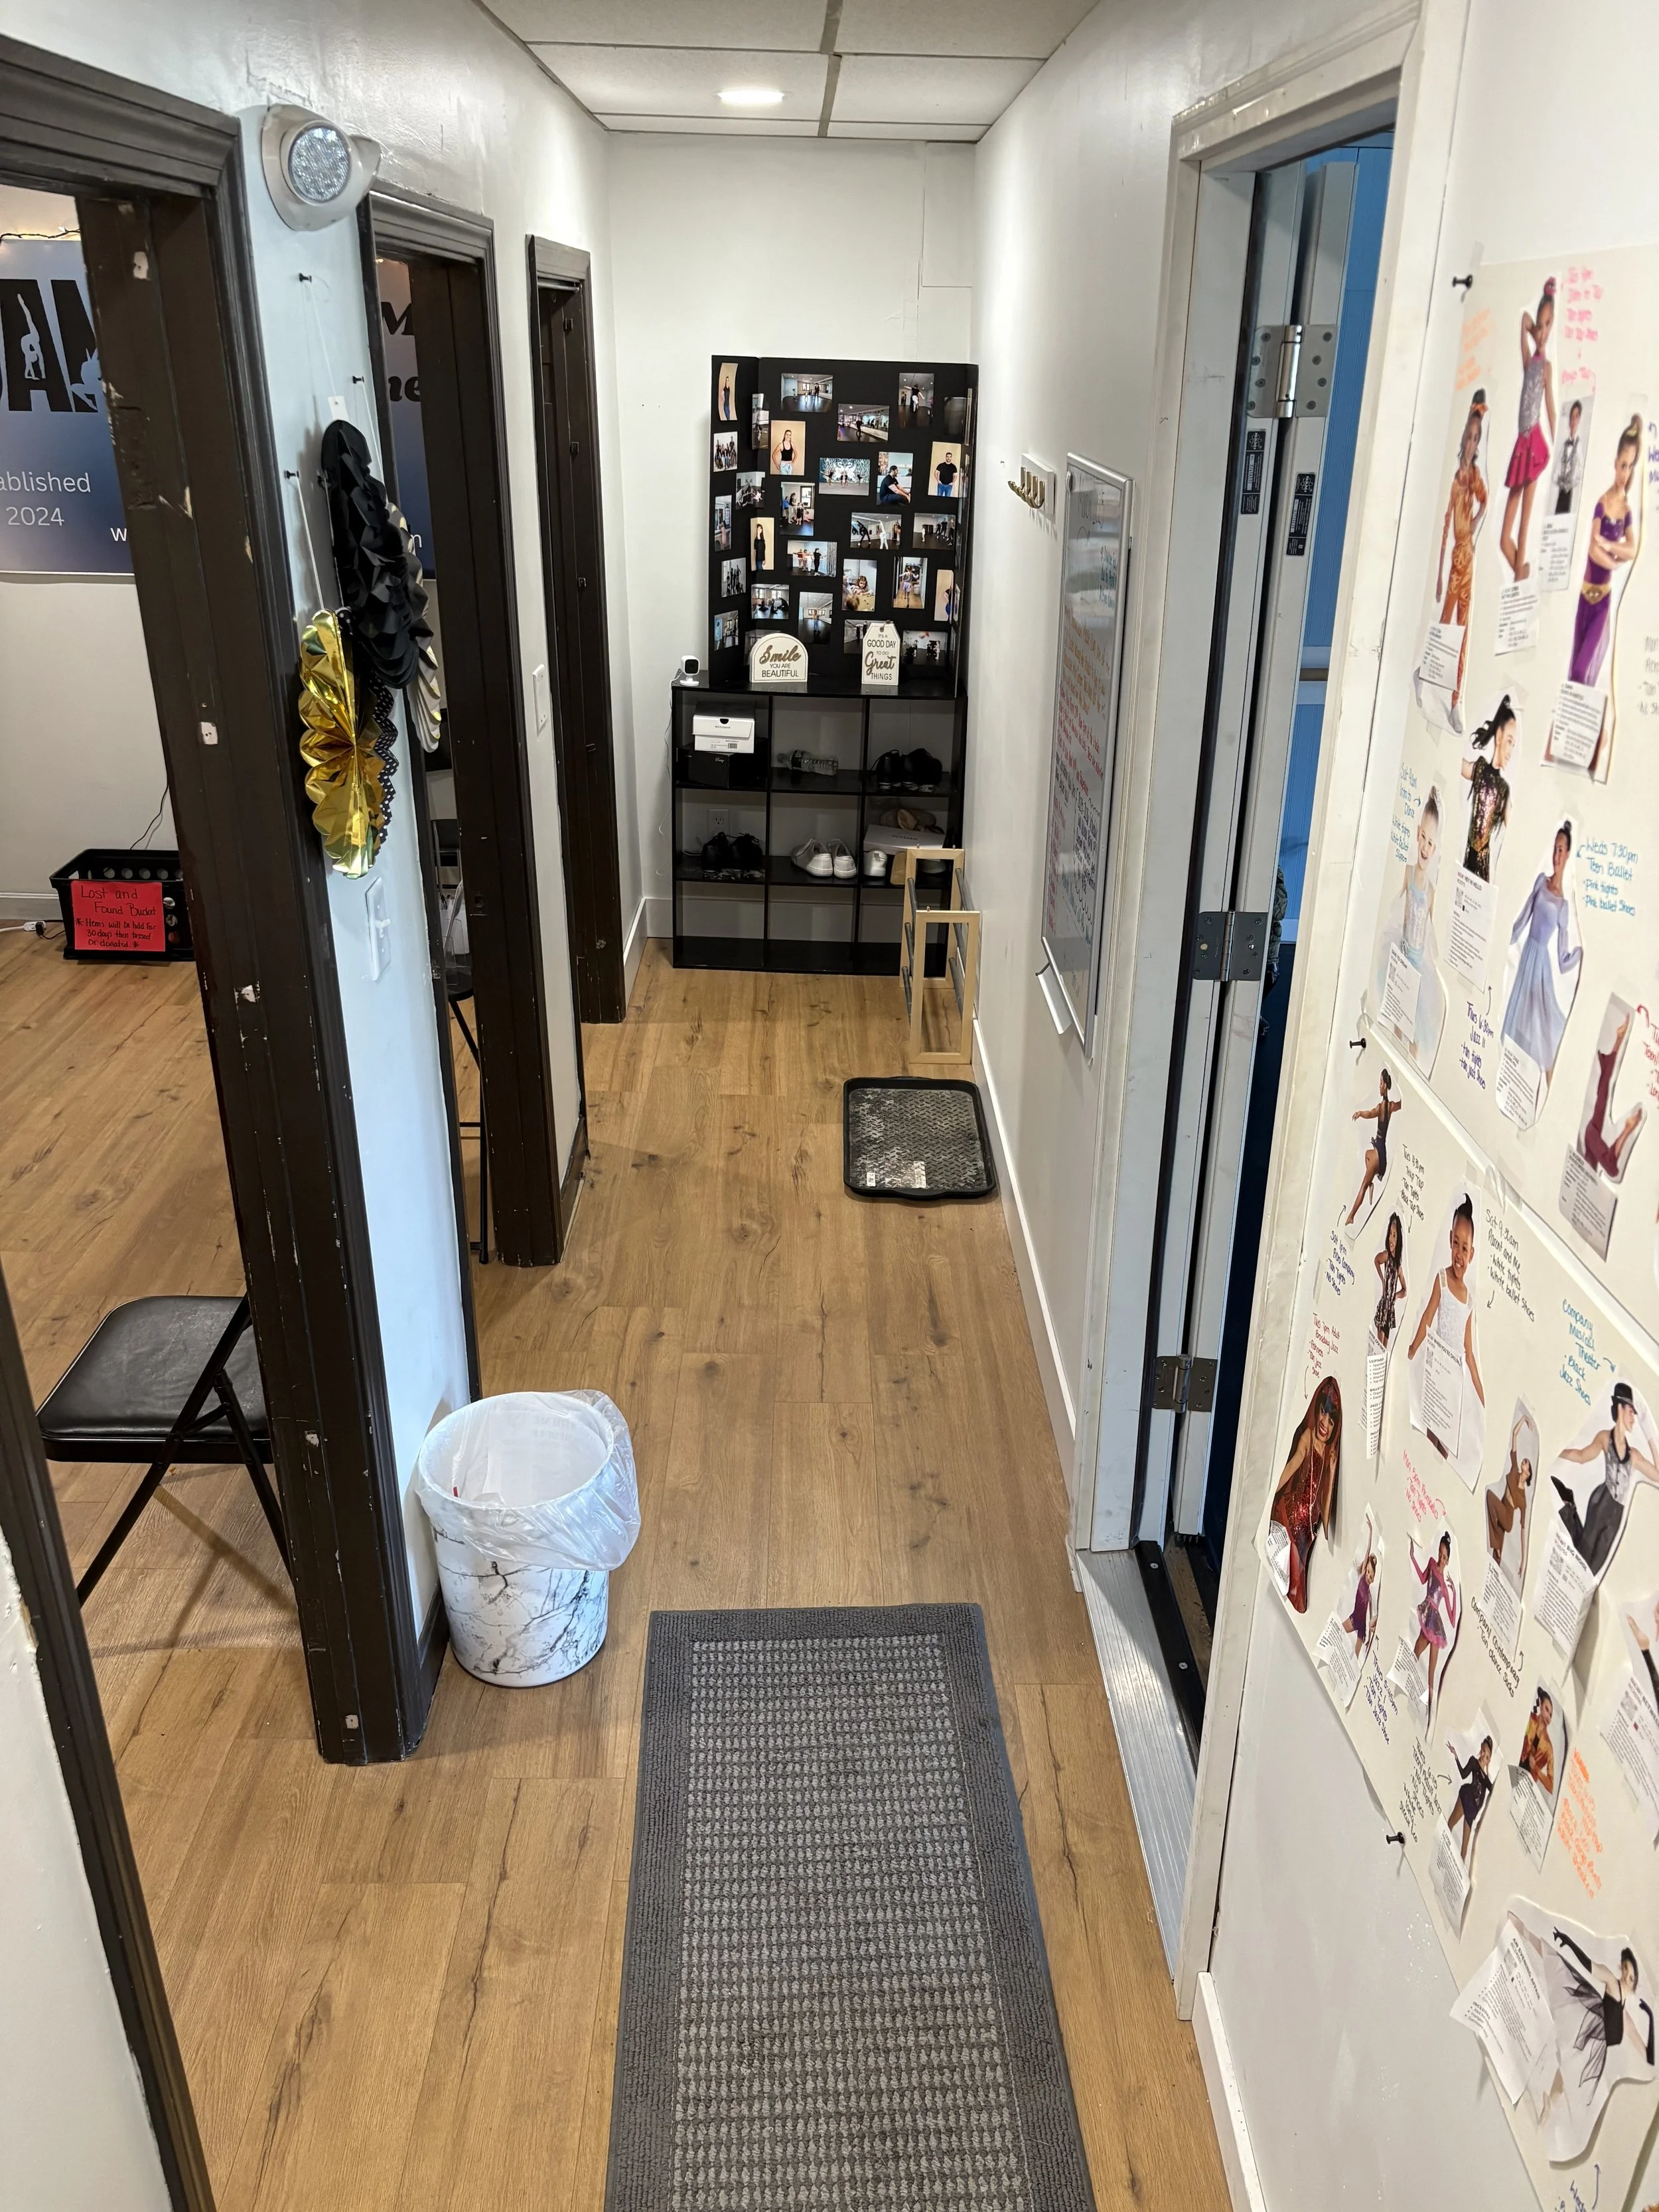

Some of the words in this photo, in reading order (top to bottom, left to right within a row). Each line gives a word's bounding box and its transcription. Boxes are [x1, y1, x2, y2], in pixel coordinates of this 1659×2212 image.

[6, 506, 64, 526] 2024
[867, 639, 885, 648] GOOD
[759, 644, 802, 664] Smile
[865, 650, 897, 676] Great
[762, 669, 799, 678] BEAUTIFUL
[1608, 861, 1632, 881] Ballet
[81, 885, 108, 899] Lost
[115, 889, 138, 899] and
[94, 901, 123, 915] Found
[126, 903, 156, 916] Bucket
[98, 930, 112, 940] days
[1486, 1209, 1498, 1229] Sat
[1488, 1228, 1502, 1252] Parent
[1471, 1596, 1491, 1639] Company
